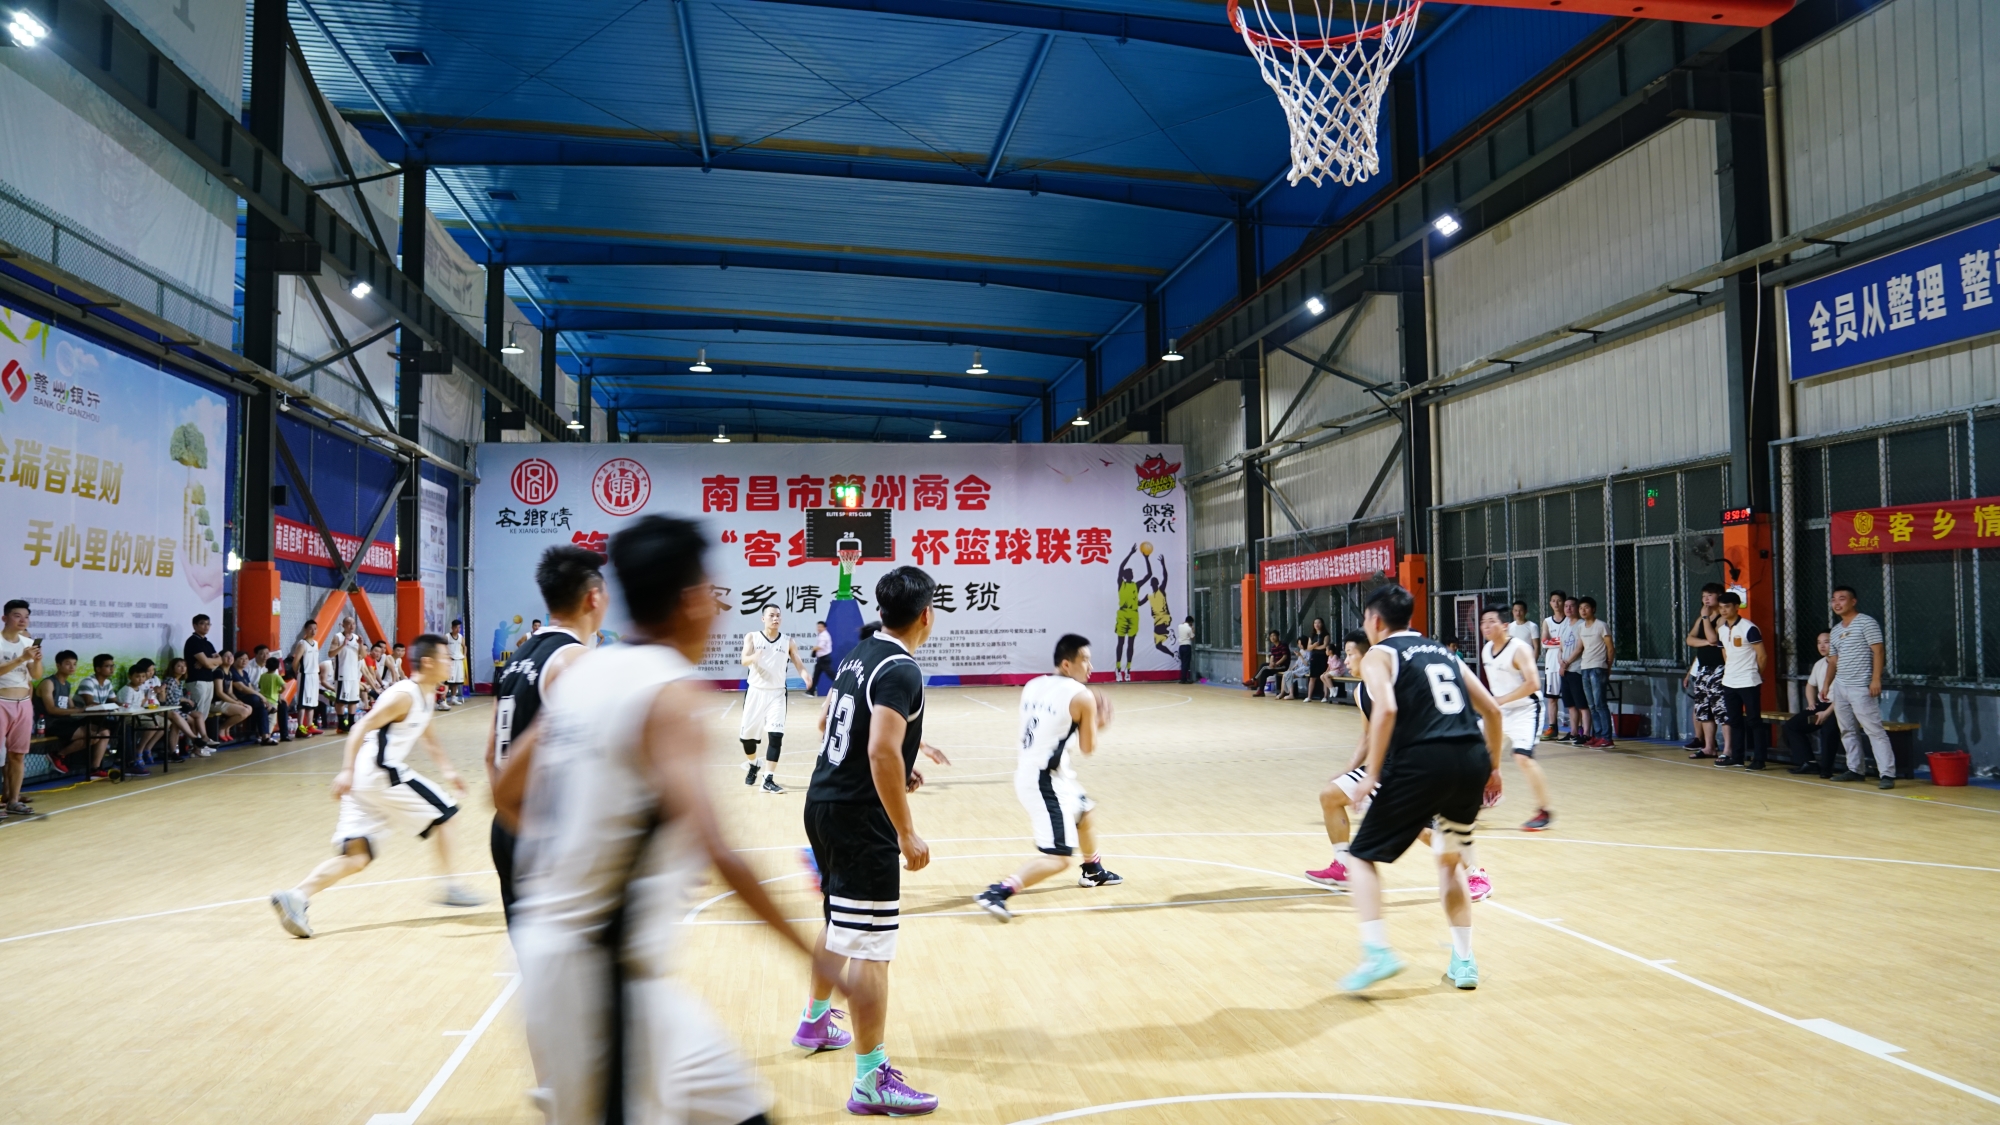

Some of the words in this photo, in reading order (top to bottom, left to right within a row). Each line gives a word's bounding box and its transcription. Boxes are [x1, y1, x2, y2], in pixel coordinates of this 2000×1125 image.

[1809, 264, 1947, 352] 全员从整理
[1959, 244, 2000, 311] 整
[33, 396, 55, 410] BANK
[56, 402, 66, 412] OF
[67, 406, 100, 423] GANZHOU
[702, 473, 991, 513] 南昌市赣州商会
[1136, 475, 1174, 492] Lobster
[1142, 503, 1175, 518] 虾客
[1143, 517, 1176, 534] 食代
[1888, 504, 2000, 543] 客乡情
[24, 519, 177, 578] 手心里的财富
[1424, 663, 1466, 715] 6
[818, 688, 856, 766] 13
